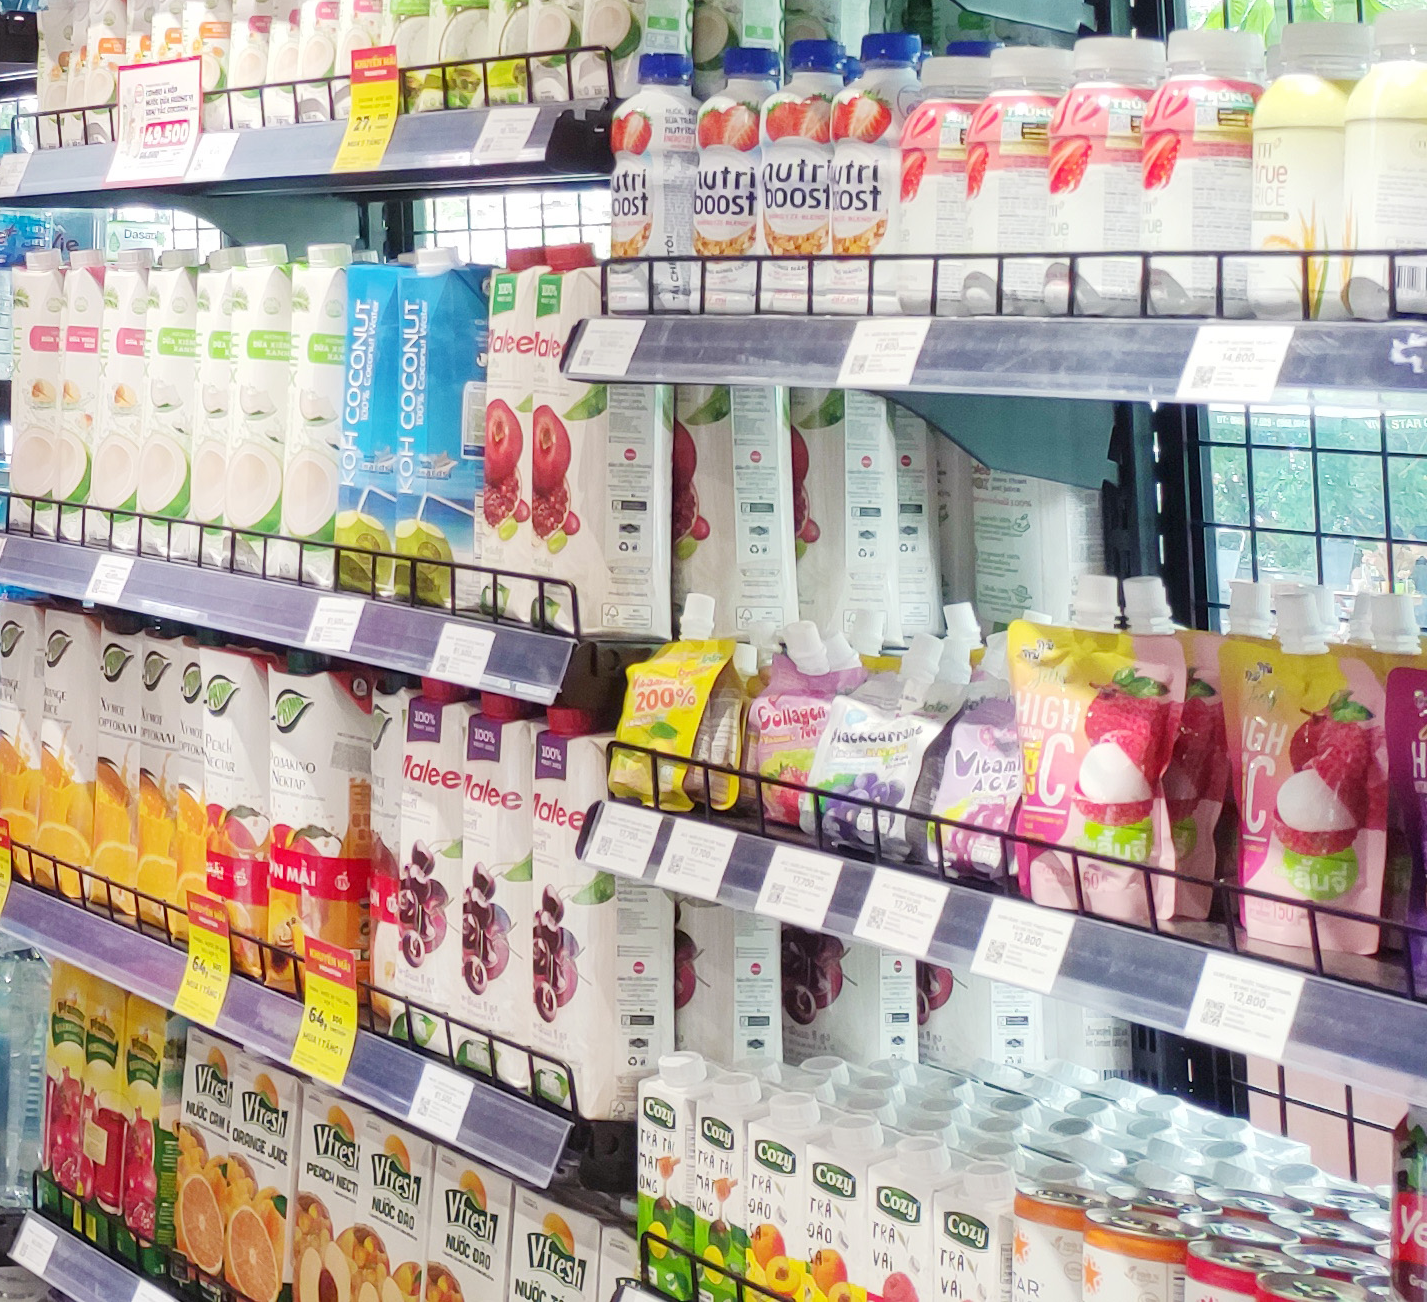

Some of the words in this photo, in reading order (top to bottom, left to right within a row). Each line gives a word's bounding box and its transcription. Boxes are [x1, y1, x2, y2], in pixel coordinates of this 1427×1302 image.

[612, 195, 648, 216] oost
[345, 299, 372, 424] COCONUT
[401, 300, 420, 430] COCONUT
[341, 431, 358, 486] KOH
[399, 436, 414, 494] KOH
[635, 688, 696, 713] 200%
[758, 703, 827, 731] Collagen
[1039, 734, 1074, 806] C
[243, 1091, 290, 1138] Vfresh
[645, 1099, 675, 1128] Cozy
[703, 1118, 733, 1149] Cozy
[756, 1142, 795, 1174] Cozy
[371, 1153, 421, 1205] Vfresh
[639, 1174, 658, 1194] ONG
[814, 1164, 853, 1197] Cozy
[446, 1189, 498, 1242] Vfresh
[696, 1198, 714, 1217] ONG
[879, 1189, 918, 1222] Cozy
[947, 1215, 987, 1249] Cozy
[527, 1232, 586, 1290] Vfresh
